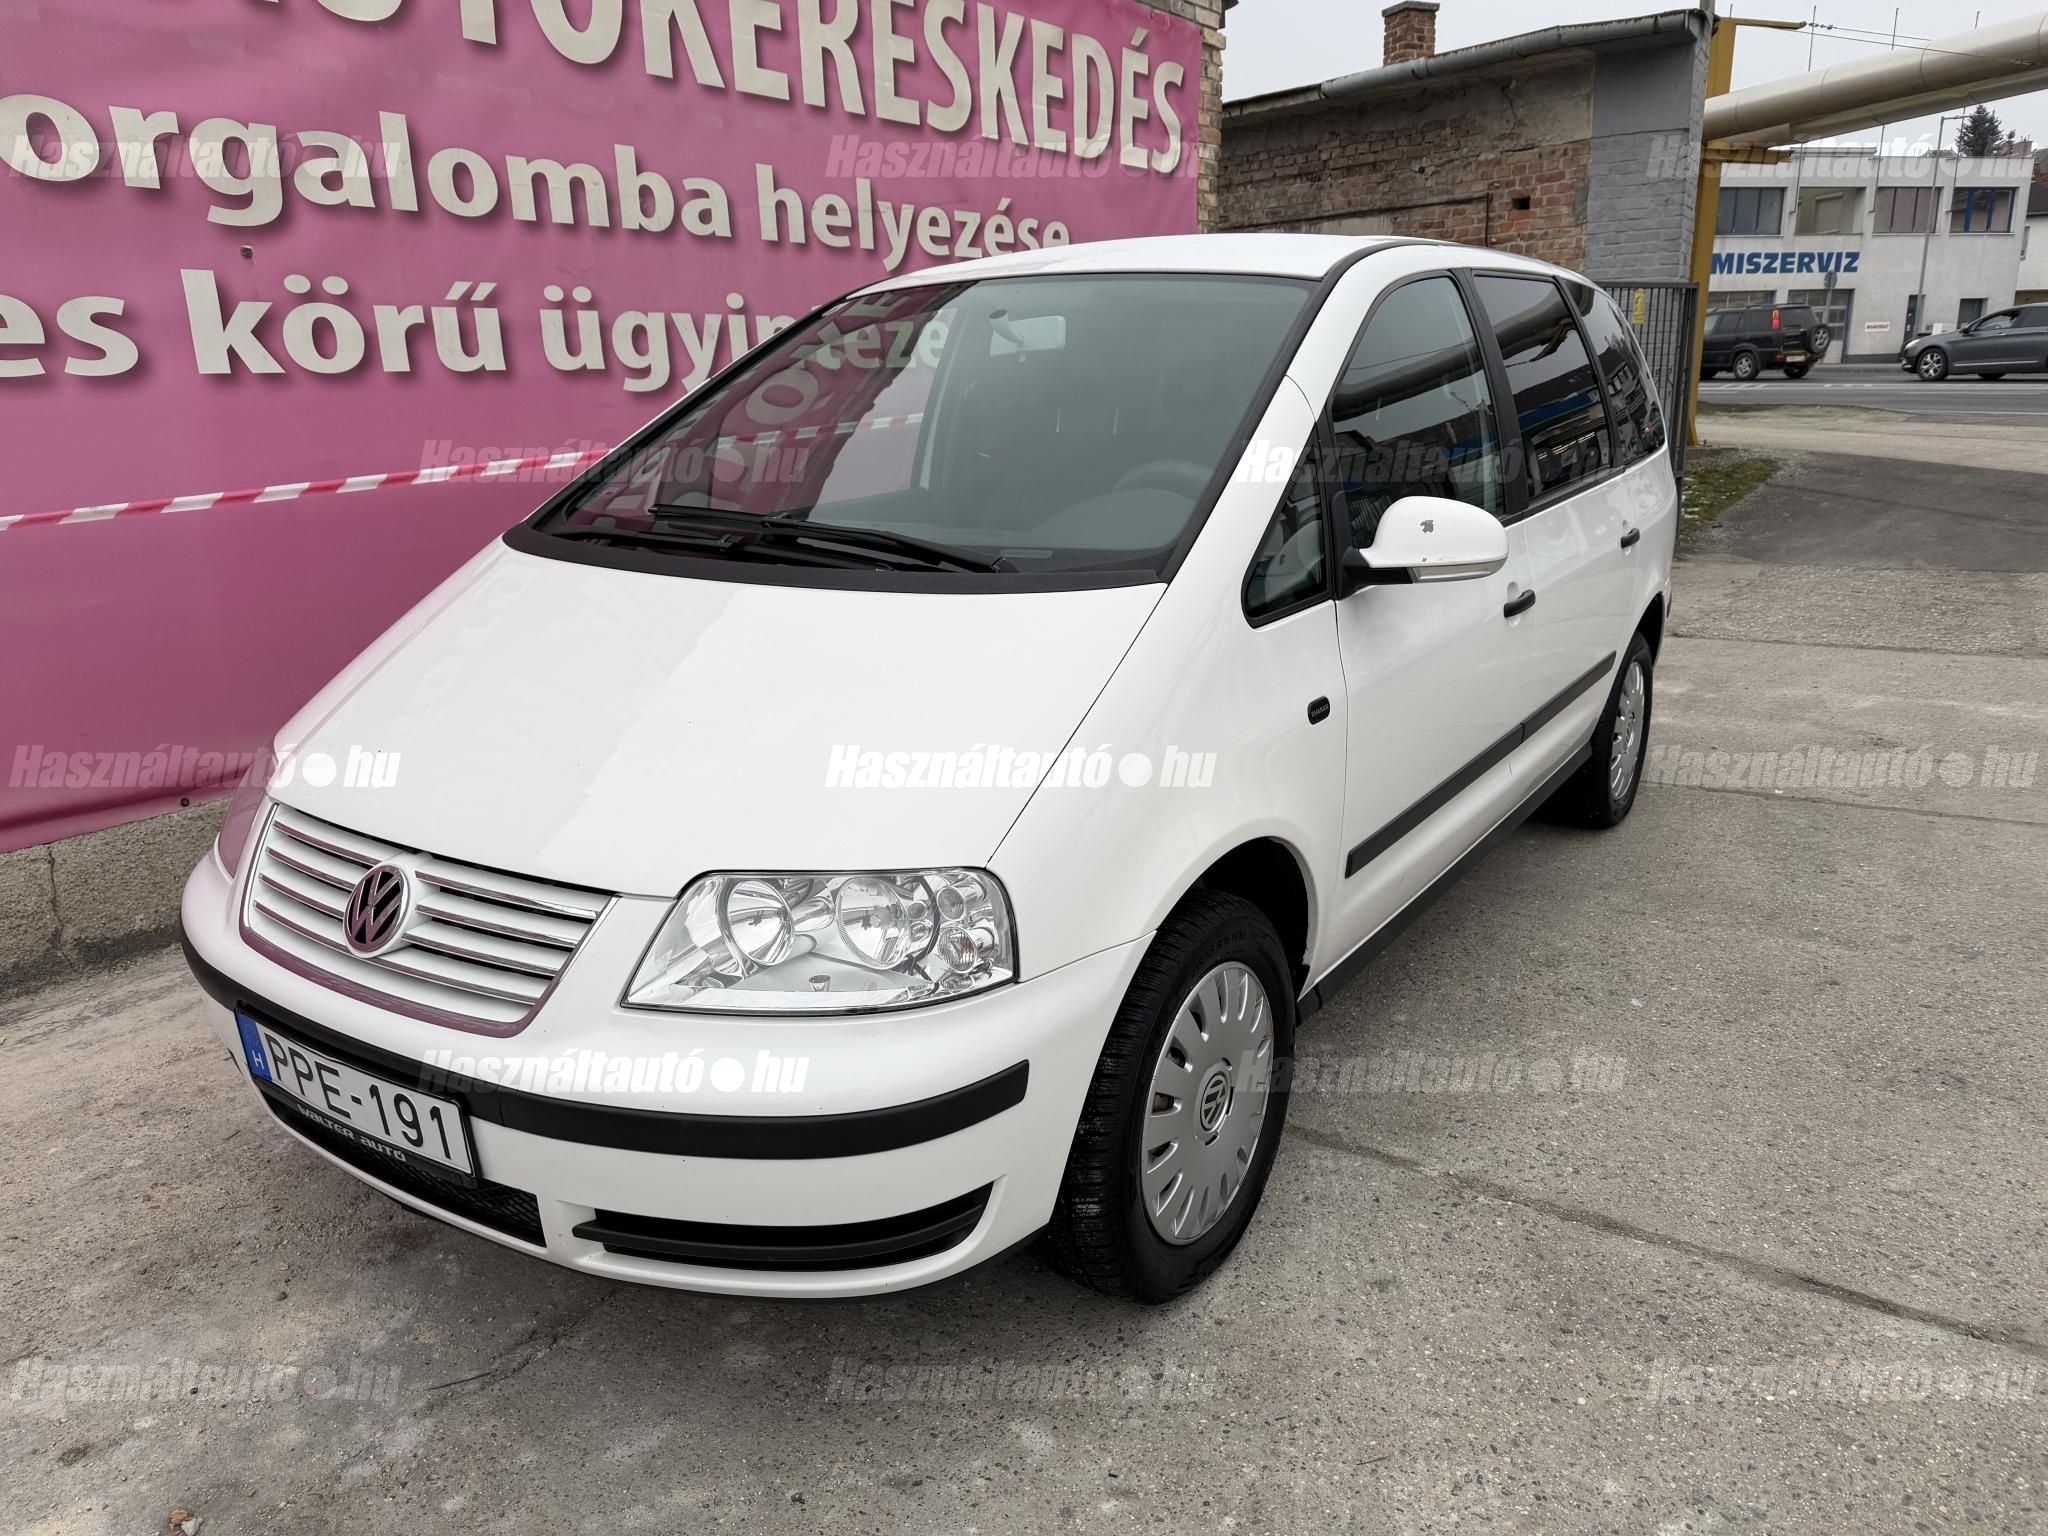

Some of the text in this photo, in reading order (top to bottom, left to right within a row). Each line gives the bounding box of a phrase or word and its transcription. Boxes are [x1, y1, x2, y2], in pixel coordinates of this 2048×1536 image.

[0, 94, 734, 236] orgalomba
[180, 268, 507, 375] körű
[1711, 252, 1860, 275] MISZERVIZ
[252, 1033, 452, 1160] H PPE-191
